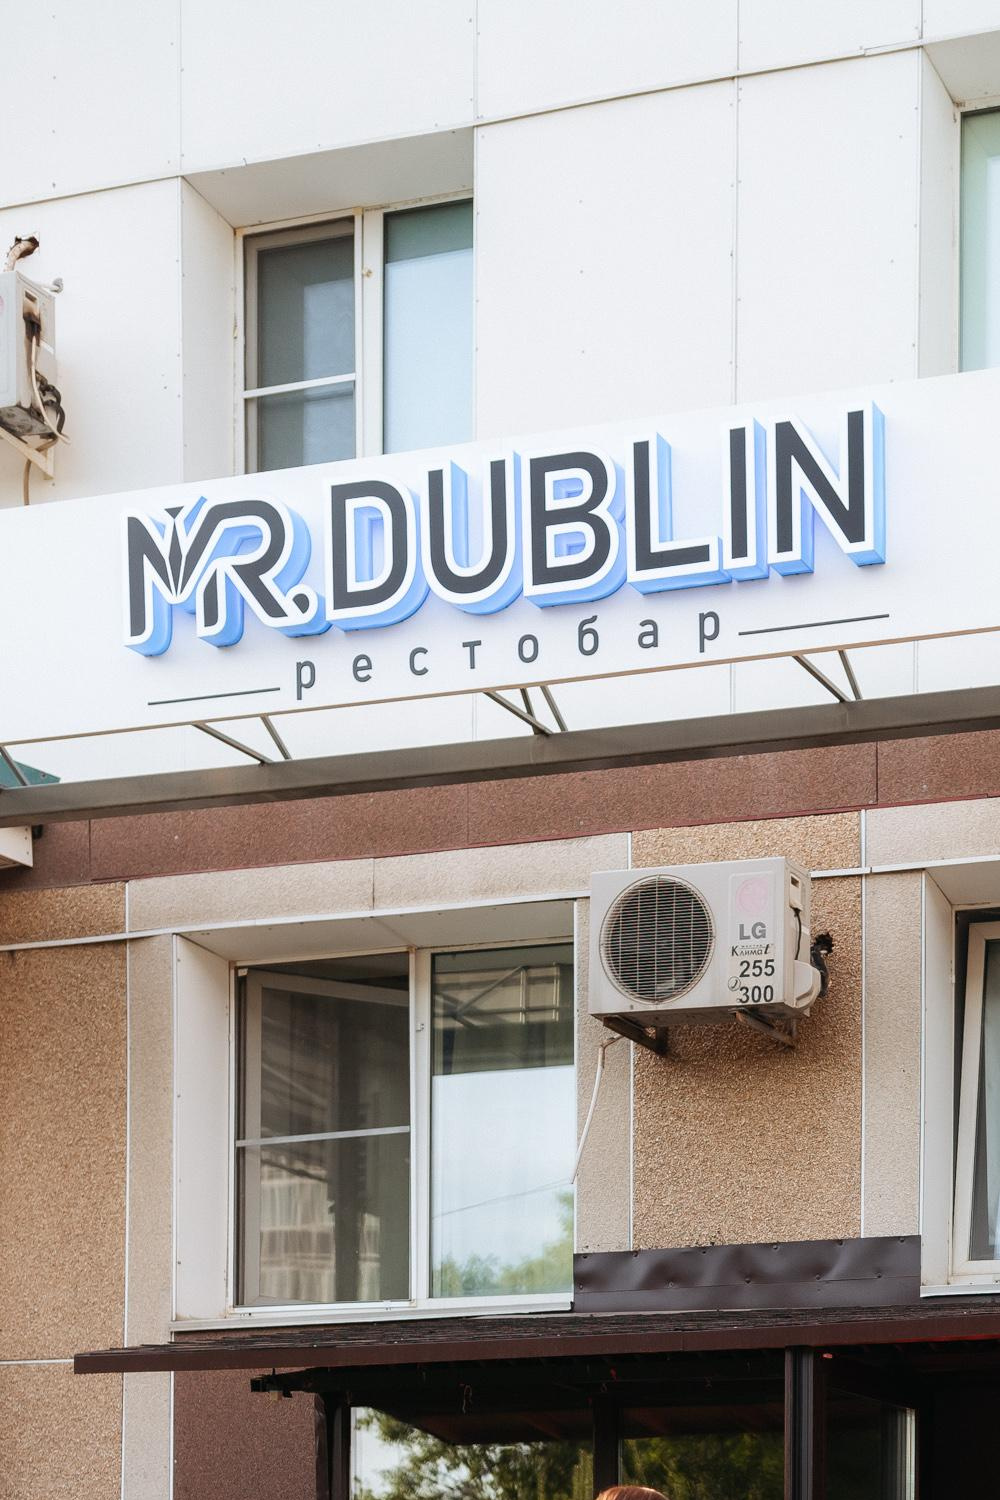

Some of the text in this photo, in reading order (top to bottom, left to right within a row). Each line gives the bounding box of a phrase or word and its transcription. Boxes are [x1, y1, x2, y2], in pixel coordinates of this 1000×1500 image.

[295, 610, 722, 699] рестобар
[739, 922, 767, 940] LG
[739, 959, 775, 978] 255
[739, 985, 774, 1003] 300
